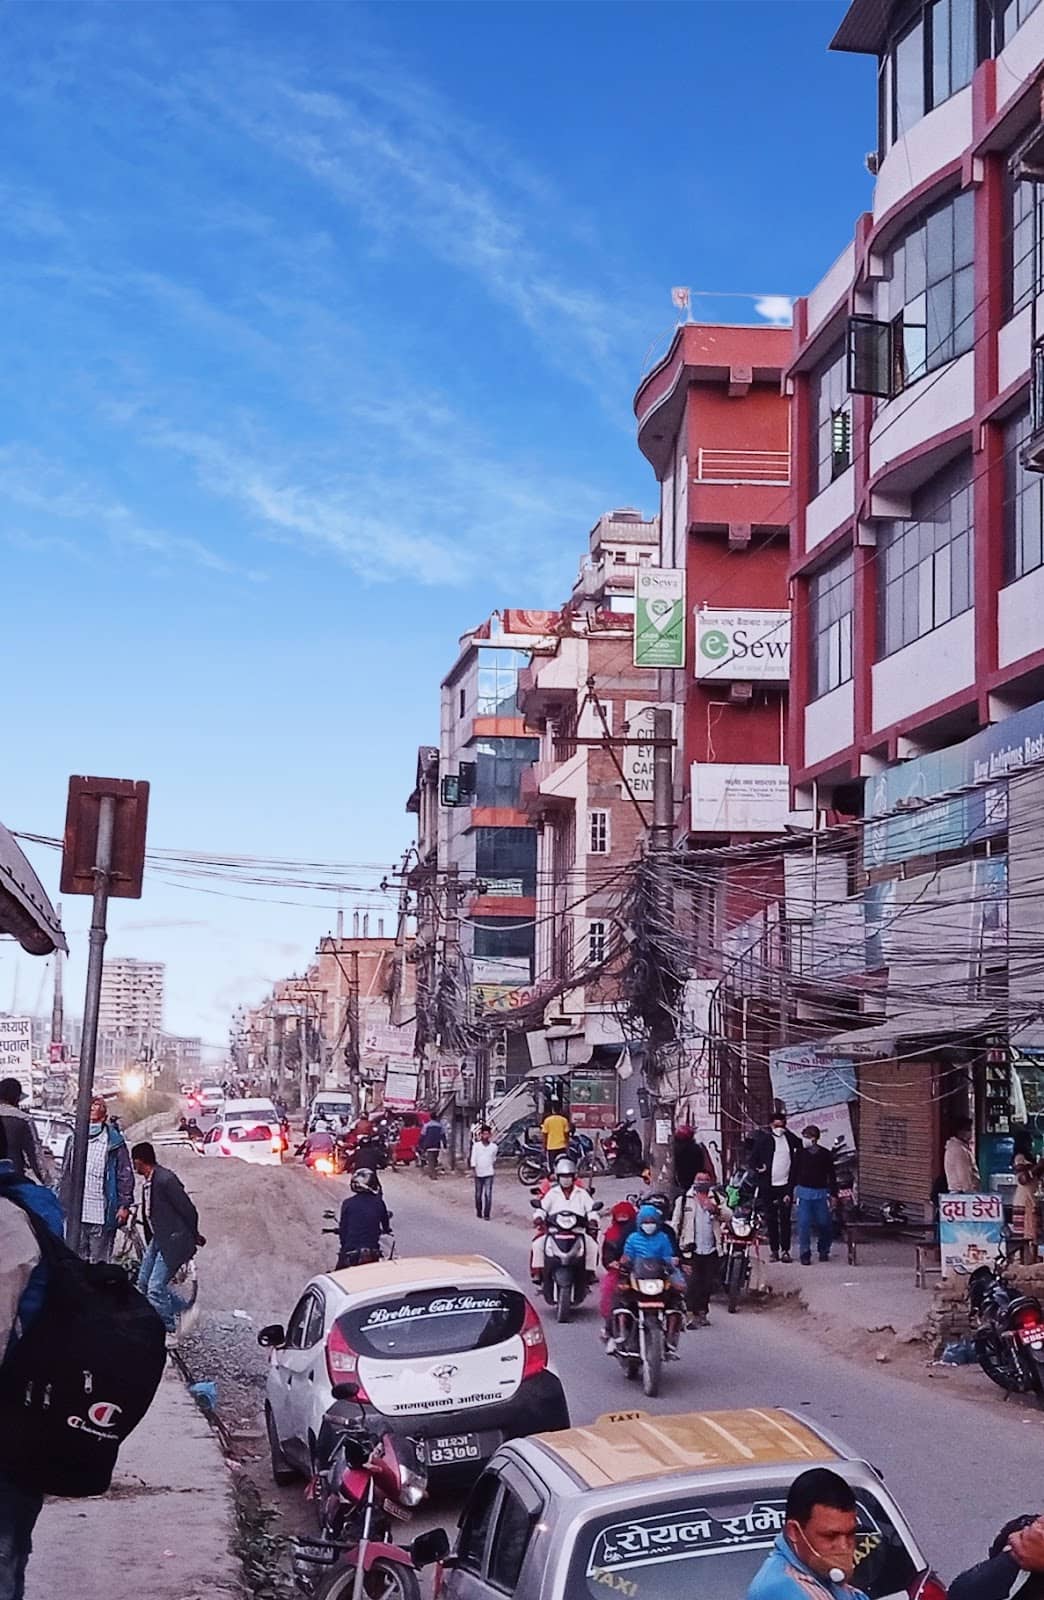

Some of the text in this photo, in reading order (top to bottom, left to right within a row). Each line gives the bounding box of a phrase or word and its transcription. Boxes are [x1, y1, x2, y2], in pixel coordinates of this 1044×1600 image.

[638, 745, 653, 758] EY
[367, 1296, 502, 1324] Brother Cab Service
[609, 1412, 640, 1423] TAXI
[615, 1515, 712, 1550] रोयल
[851, 1535, 882, 1569] AXI
[592, 1566, 639, 1598] TAXI
